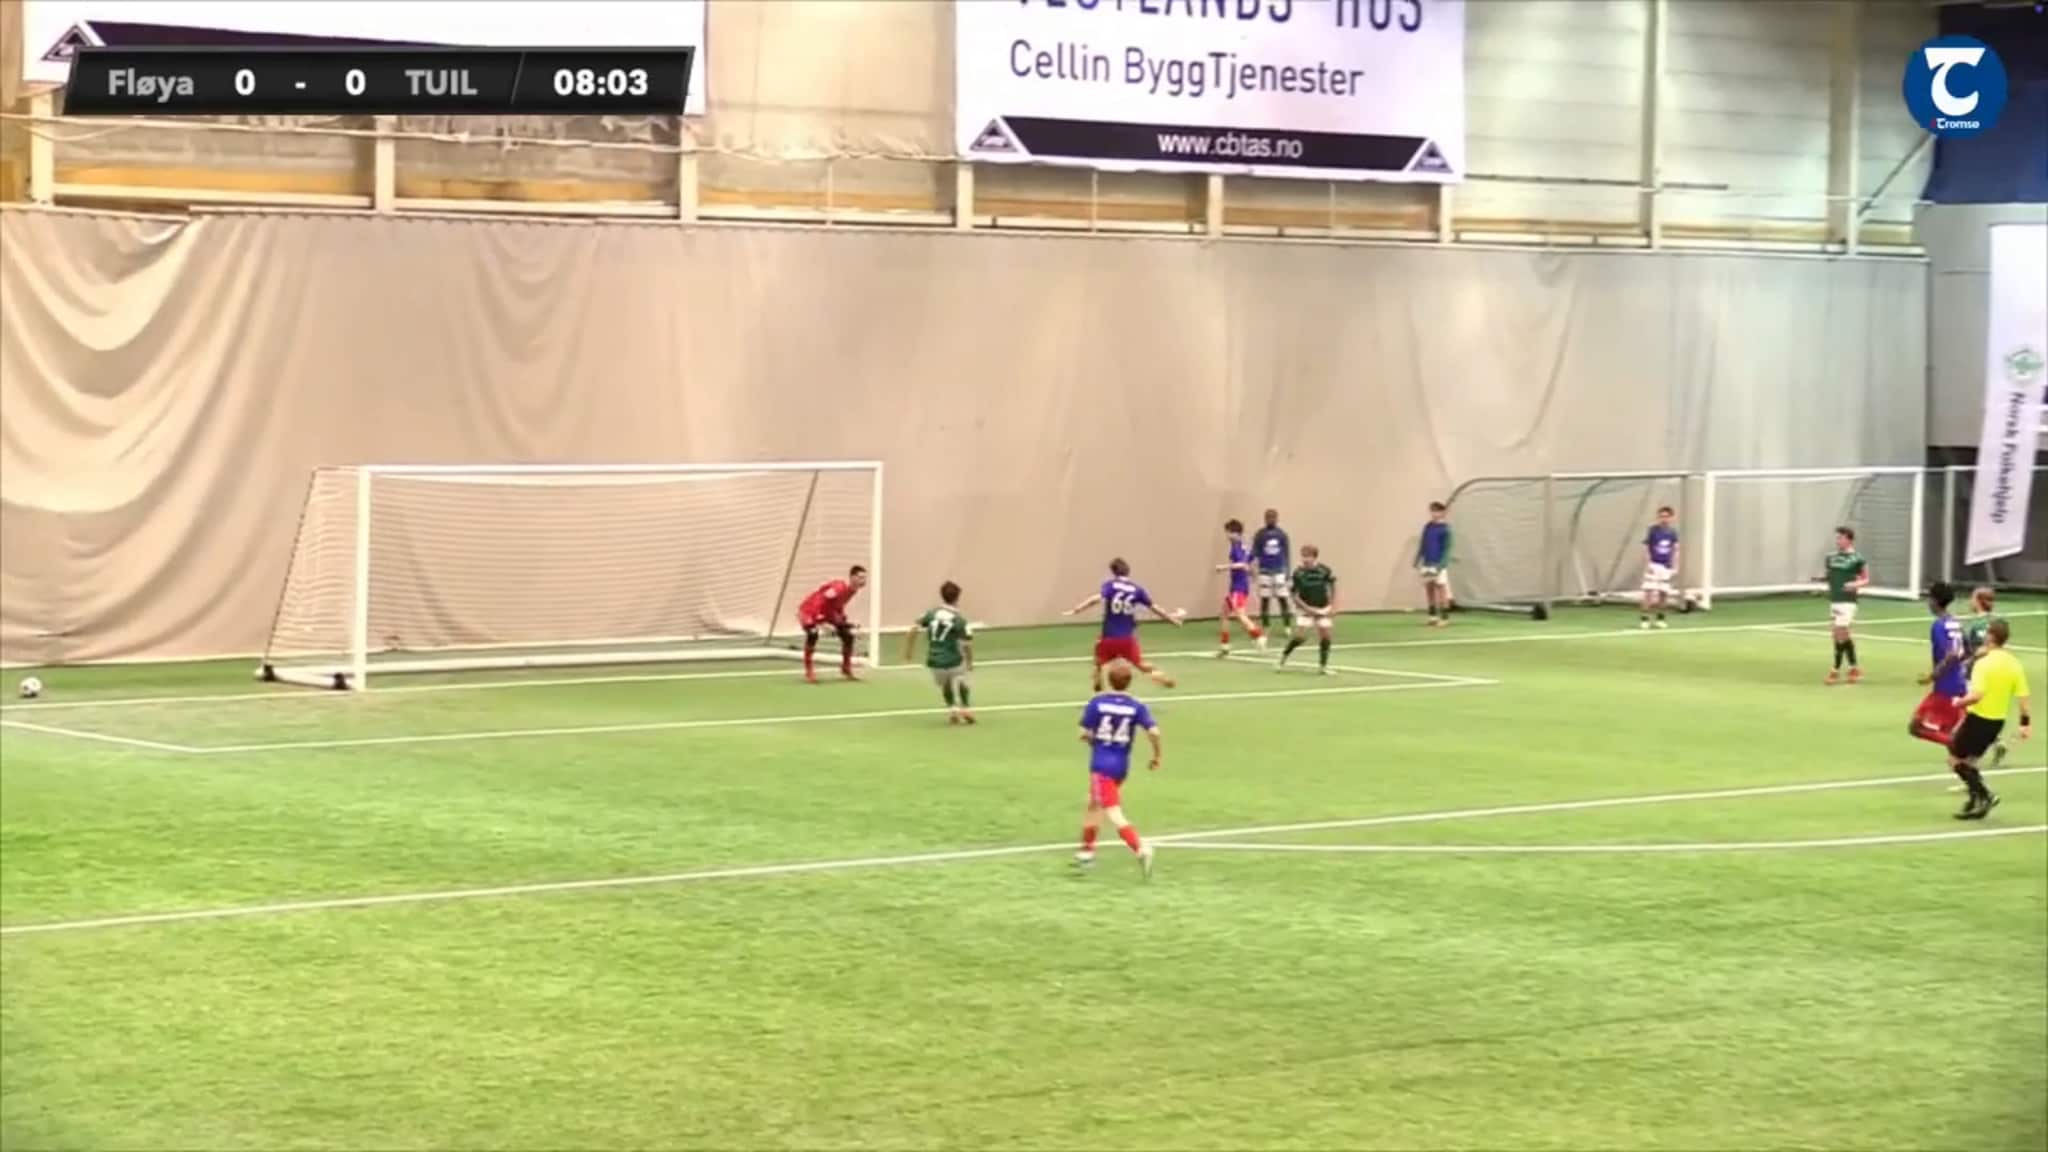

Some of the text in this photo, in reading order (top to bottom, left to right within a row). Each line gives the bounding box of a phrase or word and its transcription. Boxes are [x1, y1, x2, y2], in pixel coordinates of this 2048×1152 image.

[1010, 39, 1364, 99] Cellin ByggTjenester
[1157, 131, 1303, 158] www.cbtas.no
[1111, 591, 1135, 615] 66
[930, 620, 953, 641] 17
[1096, 715, 1131, 746] 44
